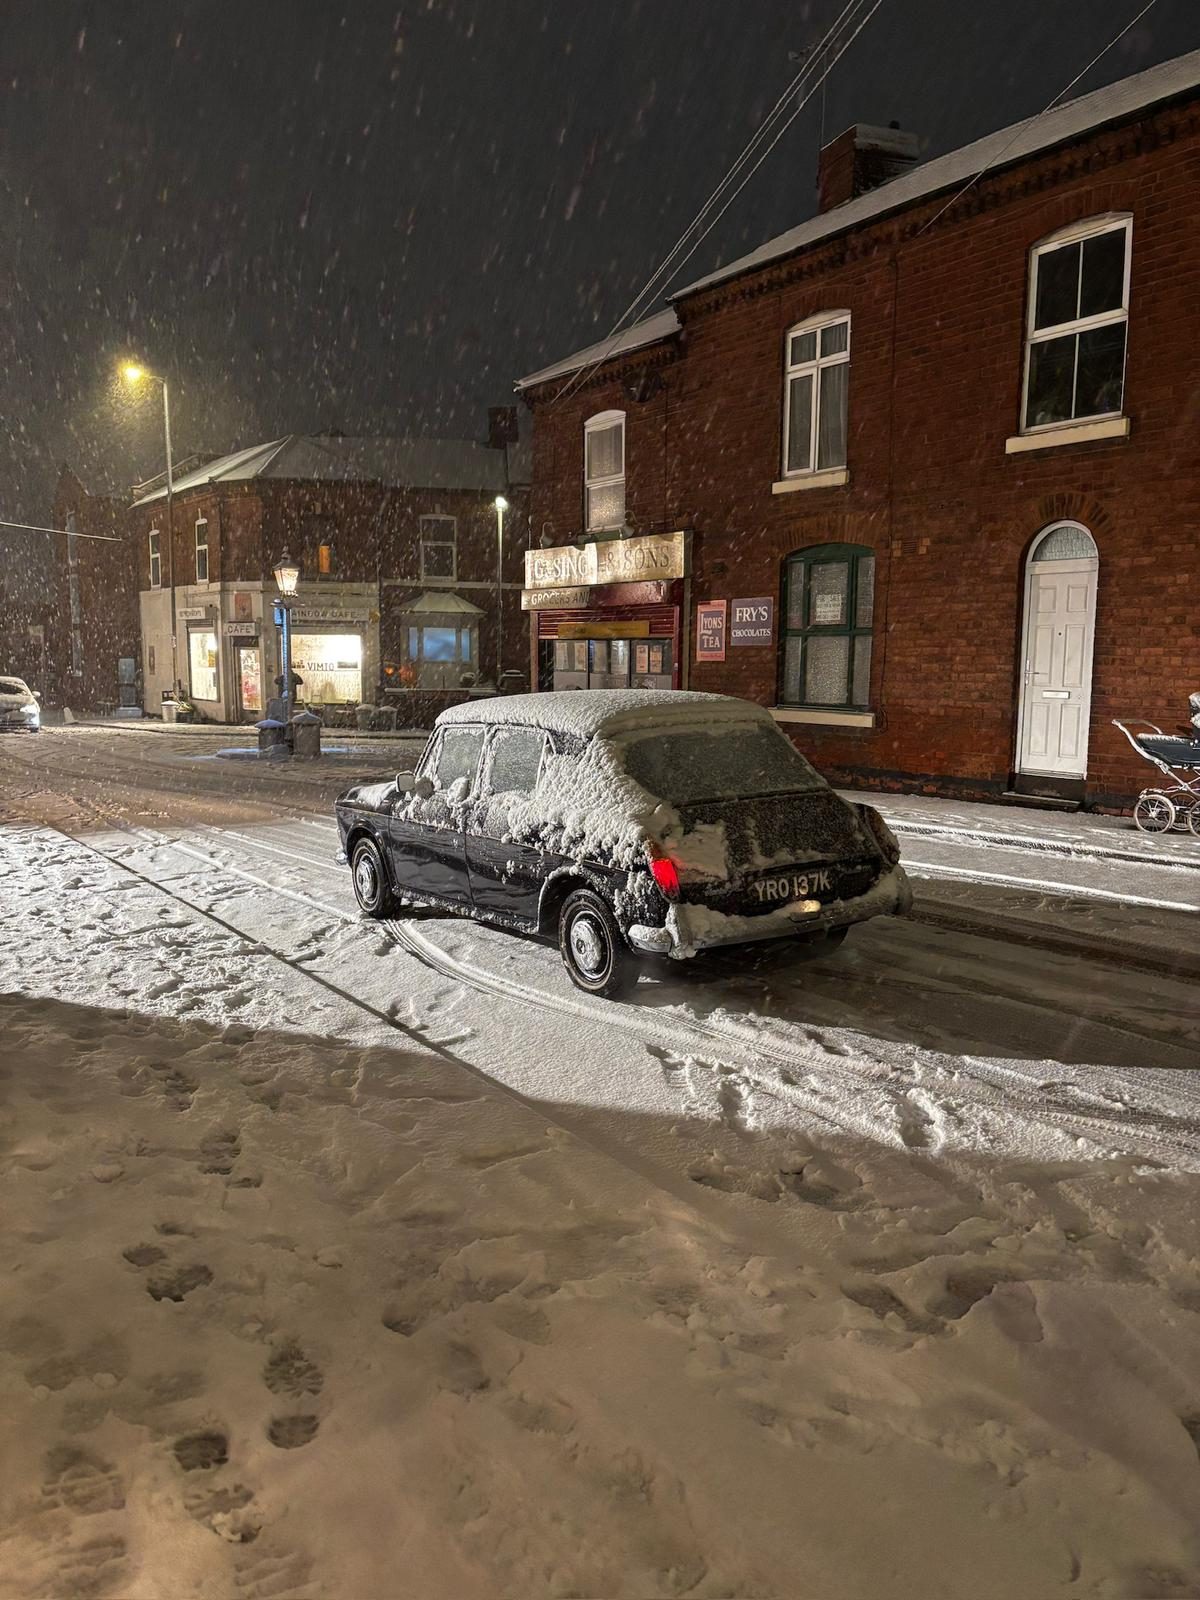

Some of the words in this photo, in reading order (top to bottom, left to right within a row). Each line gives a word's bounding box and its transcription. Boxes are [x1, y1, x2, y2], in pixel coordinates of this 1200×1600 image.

[624, 546, 670, 570] SONS
[735, 606, 768, 622] FRY'S
[227, 625, 252, 634] CAFE
[700, 613, 723, 635] LYONS
[731, 628, 771, 638] CHOCOLATES
[703, 635, 720, 648] TEA
[755, 878, 790, 901] YRO
[793, 871, 831, 896] 137K
